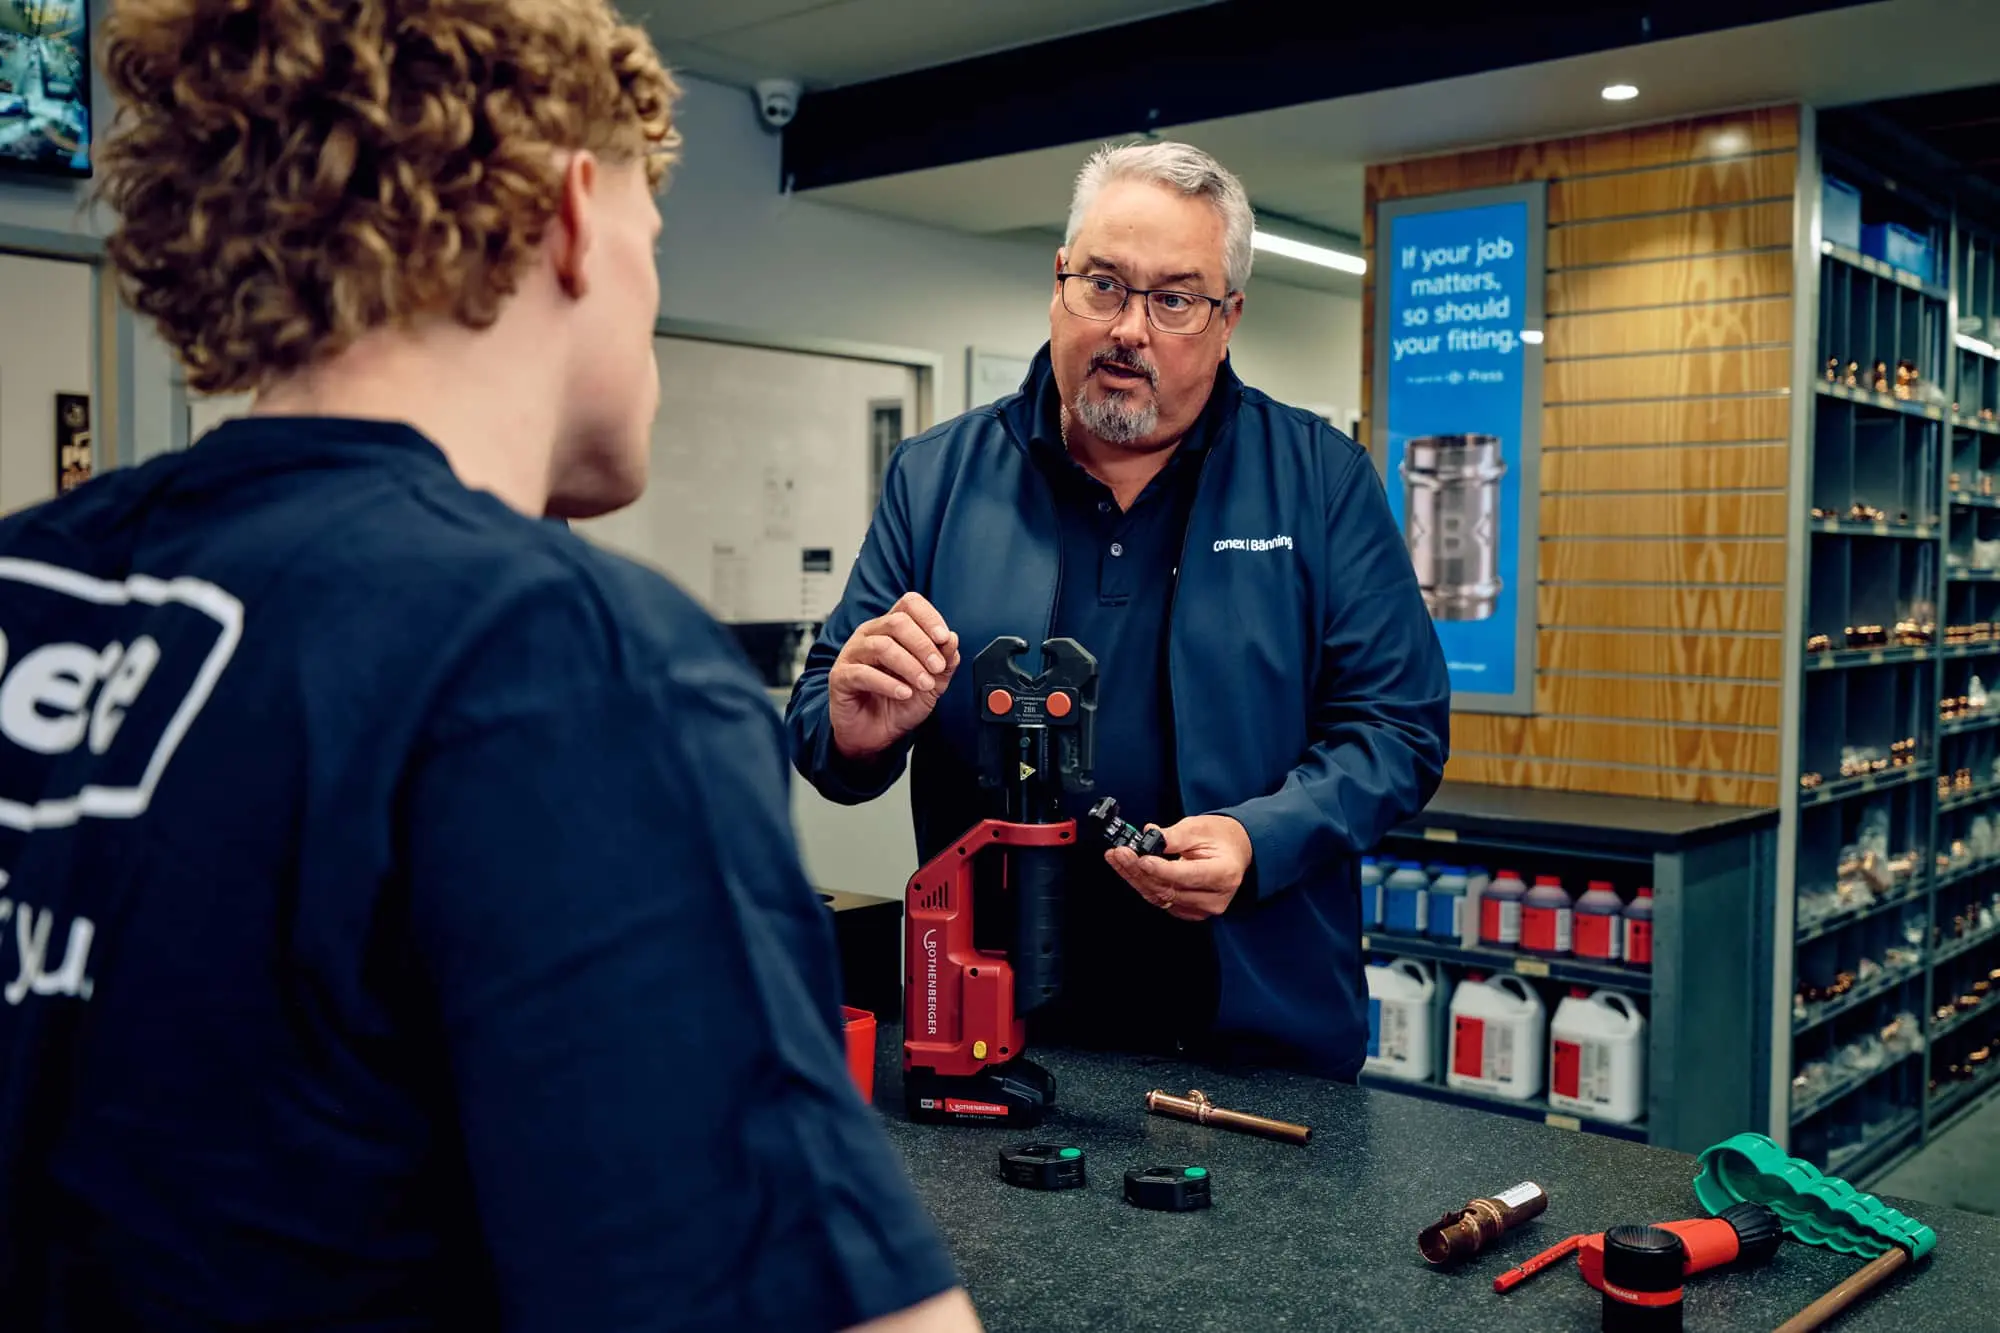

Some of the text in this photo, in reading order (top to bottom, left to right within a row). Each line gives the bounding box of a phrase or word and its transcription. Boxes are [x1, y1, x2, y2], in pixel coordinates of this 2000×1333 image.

[1402, 237, 1514, 272] If your job
[1402, 296, 1510, 326] so should
[1393, 327, 1519, 361] your fitting.
[927, 941, 937, 1035] ROTHENBERGER
